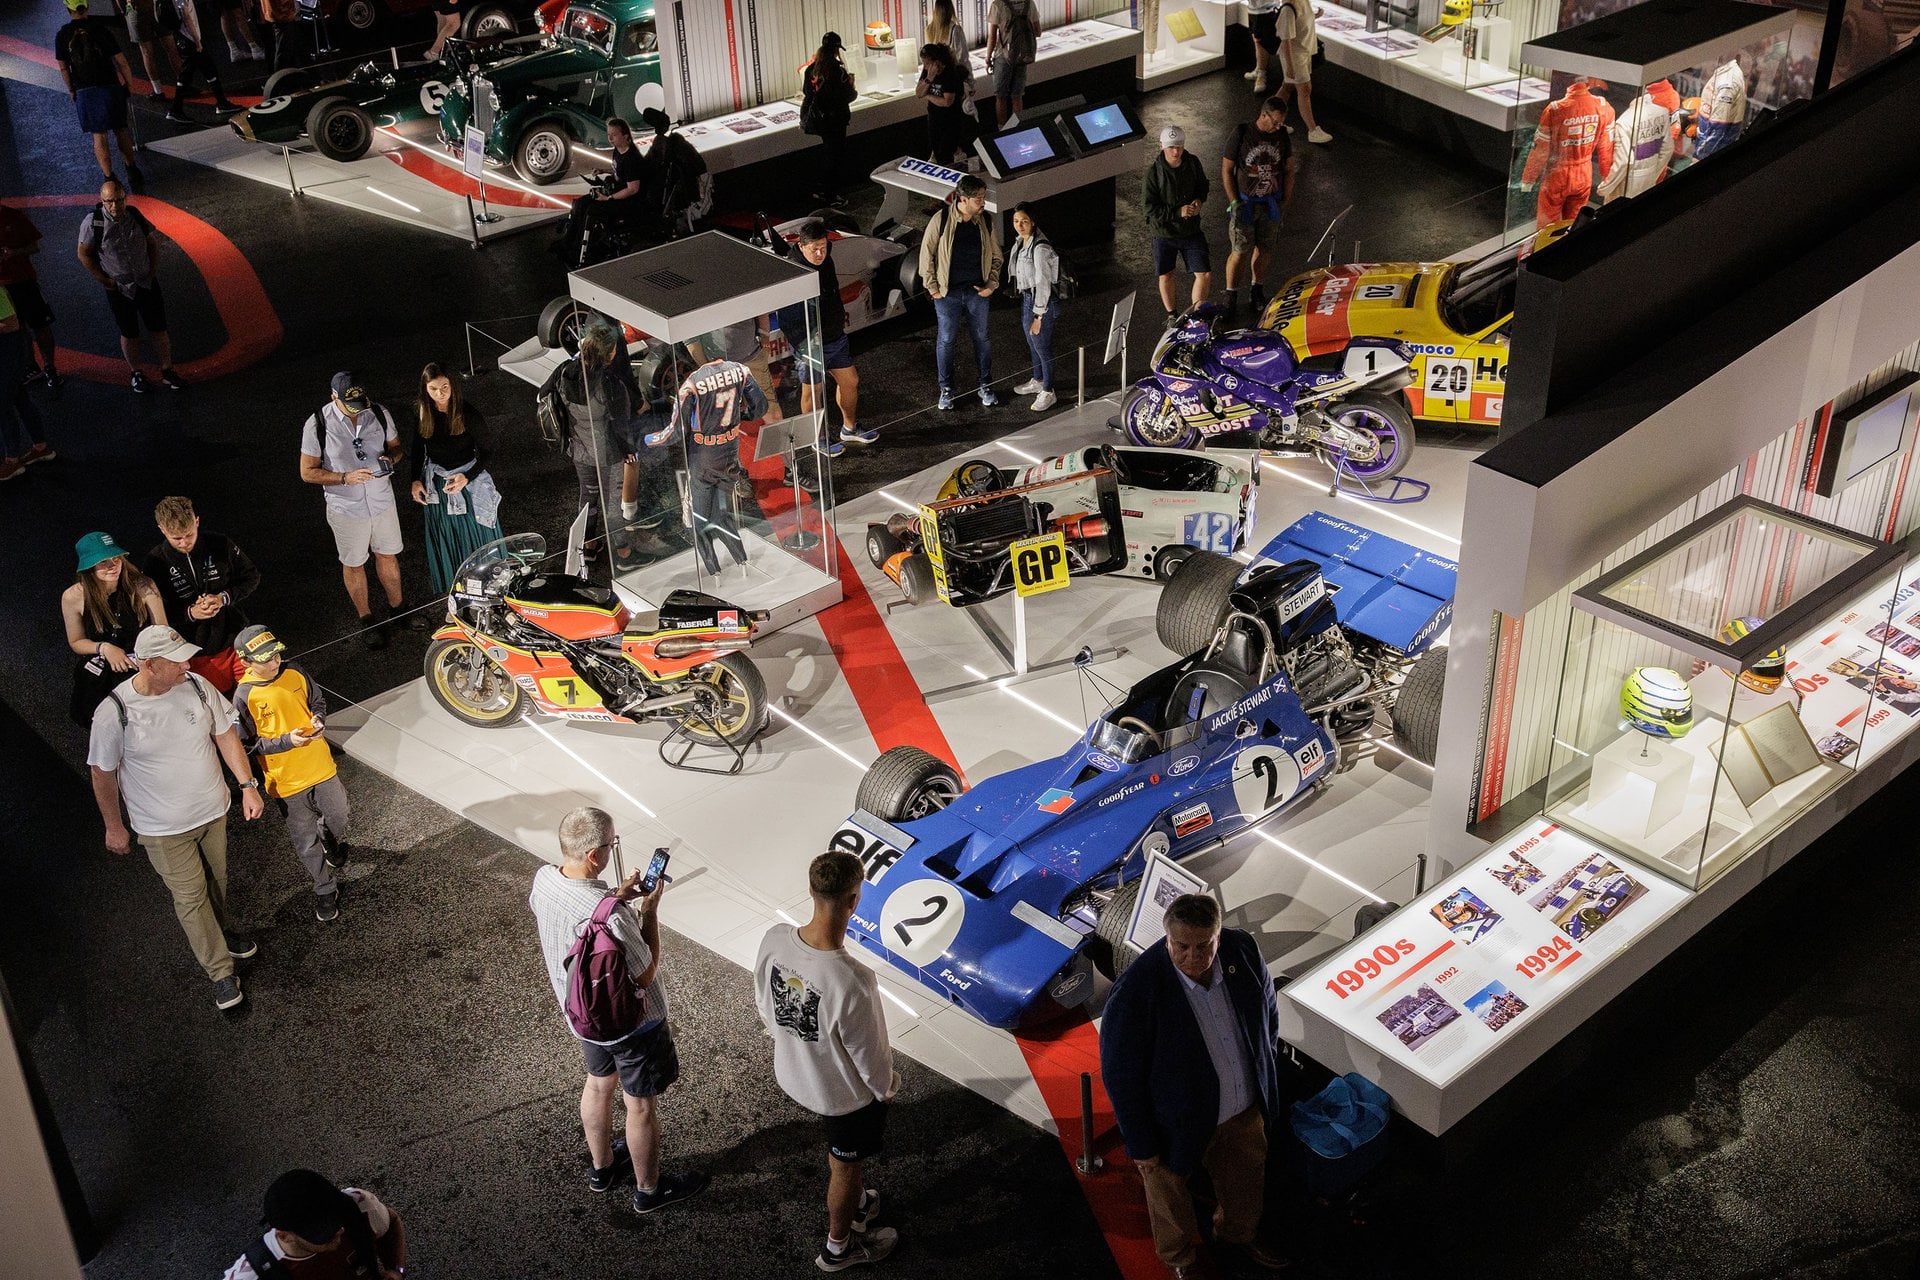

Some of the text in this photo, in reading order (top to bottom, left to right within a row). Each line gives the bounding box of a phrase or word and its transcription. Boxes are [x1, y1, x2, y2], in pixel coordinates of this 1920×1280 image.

[426, 85, 445, 112] 5
[1273, 278, 1308, 331] Hepolite
[1316, 277, 1350, 316] Glacier
[1364, 285, 1394, 299] 20
[1405, 341, 1455, 355] imoco
[1365, 350, 1379, 377] 1
[696, 368, 743, 395] SHEENE
[1431, 364, 1468, 393] 20
[716, 387, 736, 427] 7
[1200, 417, 1252, 435] BOOST
[1193, 513, 1229, 552] 42
[1317, 516, 1360, 535] GOODYEAR
[1018, 545, 1062, 587] GP
[1284, 582, 1320, 616] STEWART
[1880, 588, 1915, 613] 2003
[522, 608, 548, 618] SUZUKI
[1841, 612, 1859, 625] 2001
[1497, 655, 1505, 683] Victory
[557, 679, 576, 705] 7
[566, 713, 613, 722] TEXACO
[1210, 688, 1272, 731] JACKIE STEWART
[1866, 709, 1891, 728] 1999
[1094, 754, 1116, 771] Ford
[1174, 758, 1194, 774] Ford
[1300, 743, 1320, 764] elf
[1486, 748, 1494, 773] British
[1098, 781, 1145, 808] GOODYEAR
[1252, 755, 1283, 811] 2
[1470, 772, 1478, 798] British
[1469, 799, 1474, 808] GP
[1493, 796, 1498, 806] GP
[1174, 804, 1209, 825] Motorcraft
[828, 829, 904, 881] elf
[1516, 837, 1540, 854] 1995
[893, 895, 949, 947] 2
[1325, 938, 1416, 999] 1990s
[1515, 935, 1573, 979] 1994
[940, 968, 971, 991] Ford
[1059, 978, 1080, 994] Ford
[1434, 966, 1459, 984] 1992
